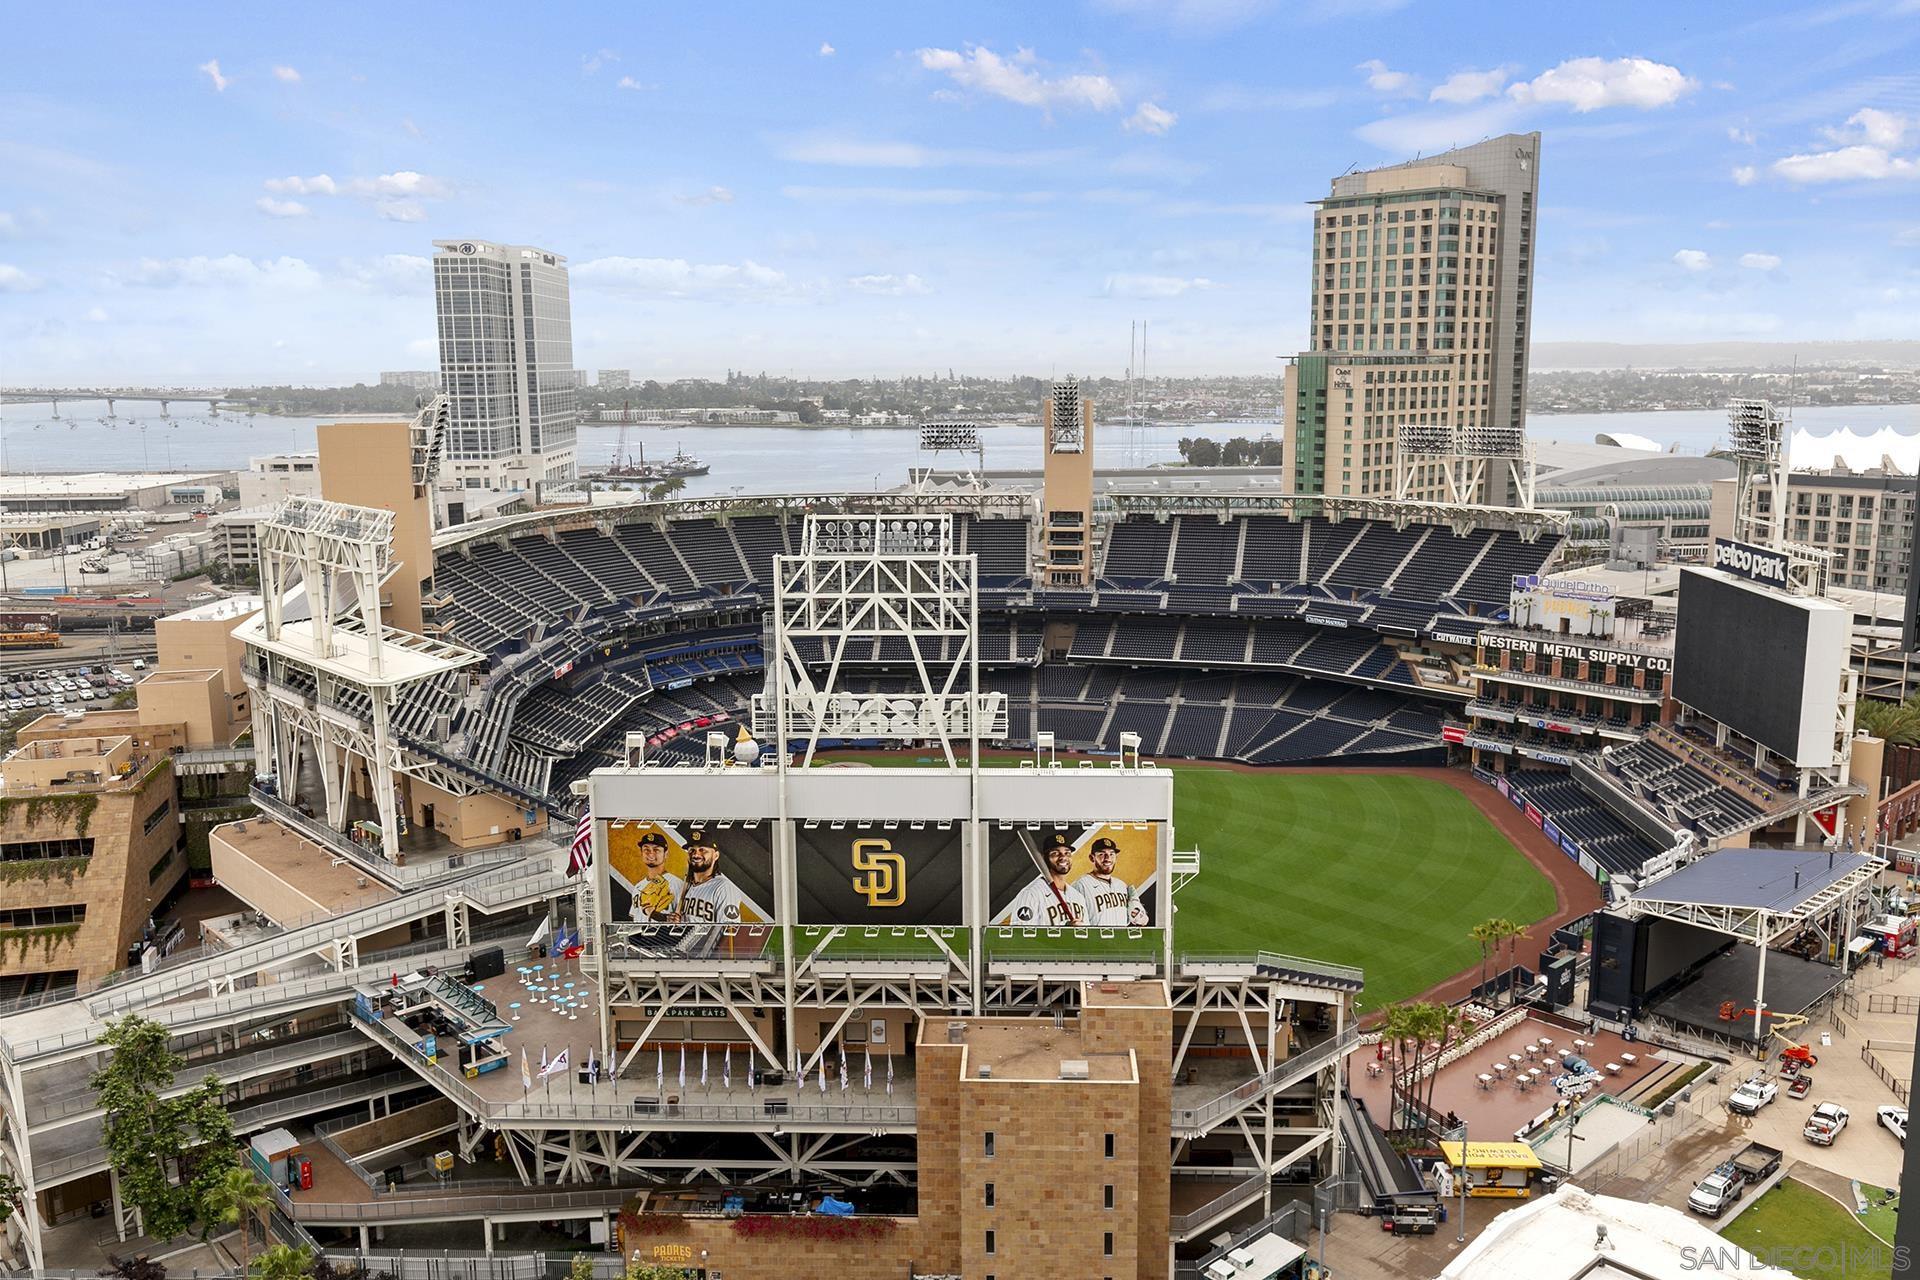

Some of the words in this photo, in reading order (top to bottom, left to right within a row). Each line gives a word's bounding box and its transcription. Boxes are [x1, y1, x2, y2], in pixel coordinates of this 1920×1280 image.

[1714, 543, 1752, 571] petco
[1751, 554, 1786, 582] park
[1436, 633, 1472, 645] CUTWATER
[1480, 634, 1538, 653] WESTERN
[1543, 643, 1586, 660] METAL
[1588, 649, 1641, 668] SUPPLY
[1646, 657, 1671, 672] CO.
[851, 838, 907, 907] SD
[1556, 1070, 1600, 1088] Gallagher
[1561, 1082, 1594, 1097] Square
[653, 1244, 692, 1258] PADRES
